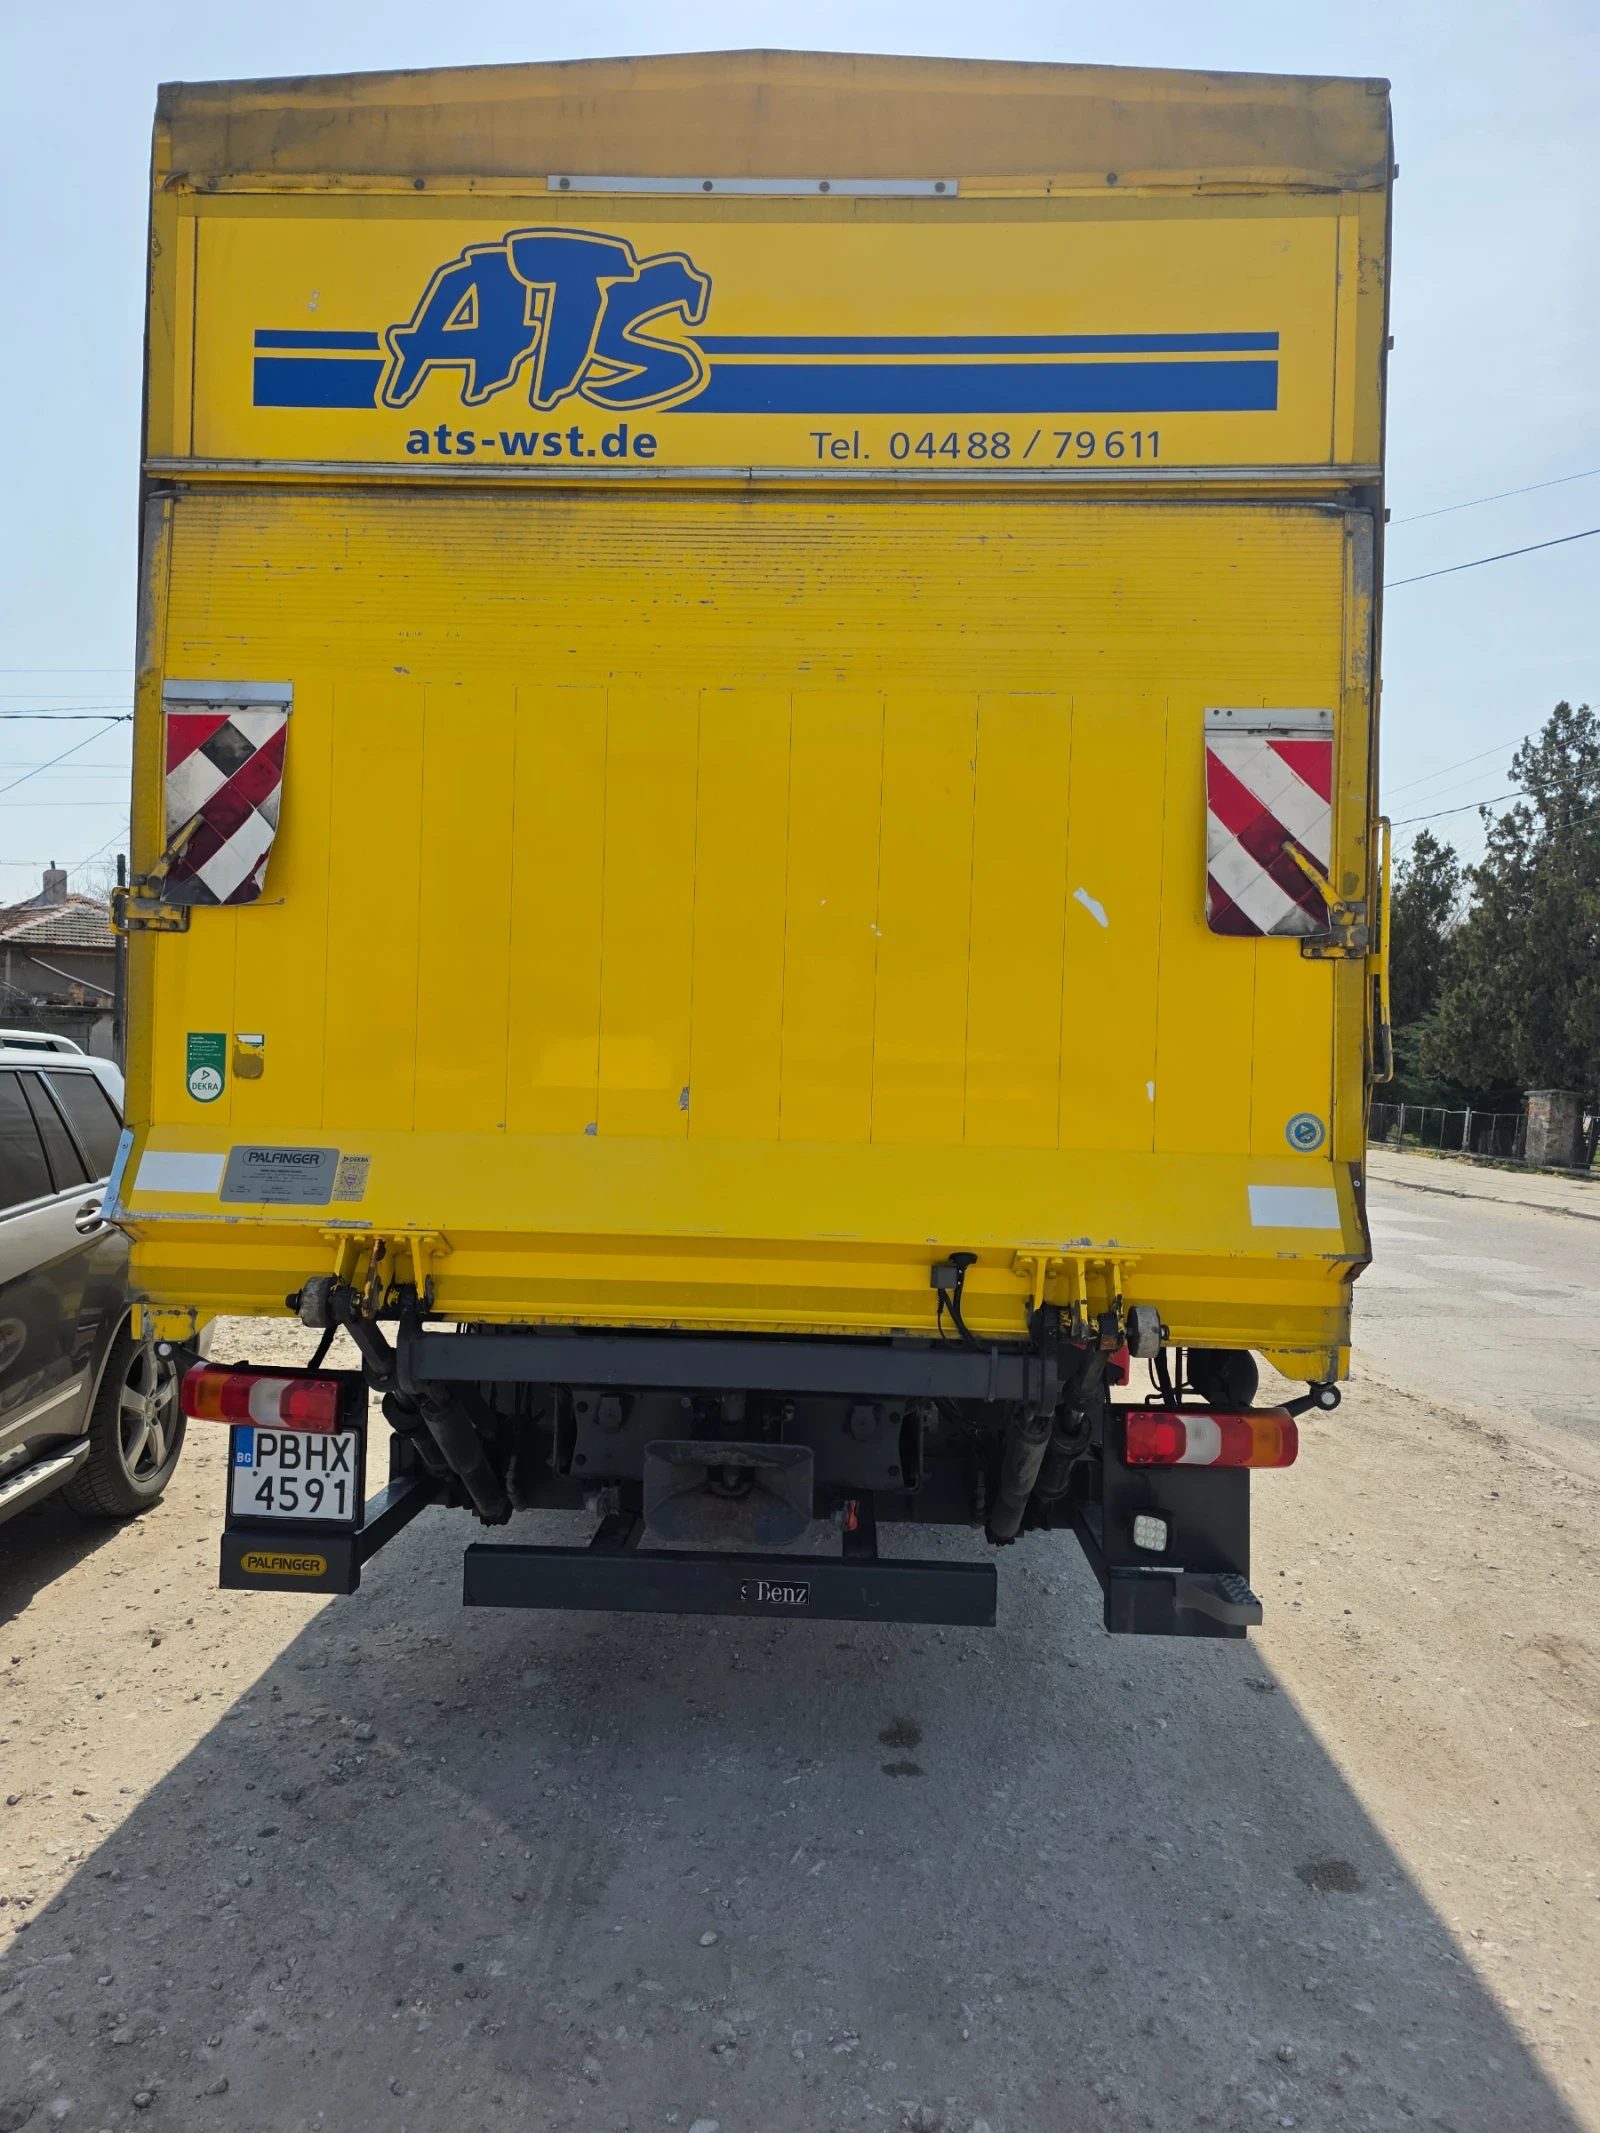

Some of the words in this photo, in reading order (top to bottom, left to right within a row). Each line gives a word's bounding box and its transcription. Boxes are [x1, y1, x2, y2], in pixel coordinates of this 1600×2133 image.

[380, 227, 712, 411] ATS
[406, 423, 658, 458] ats-wst.de
[810, 431, 870, 459] Tel.
[889, 431, 1011, 460] 04488
[192, 1082, 219, 1091] DEKRA
[247, 1152, 320, 1165] PALFINGER
[236, 1452, 252, 1463] BG
[254, 1475, 346, 1515] 4591
[247, 1556, 320, 1572] PALFINGER
